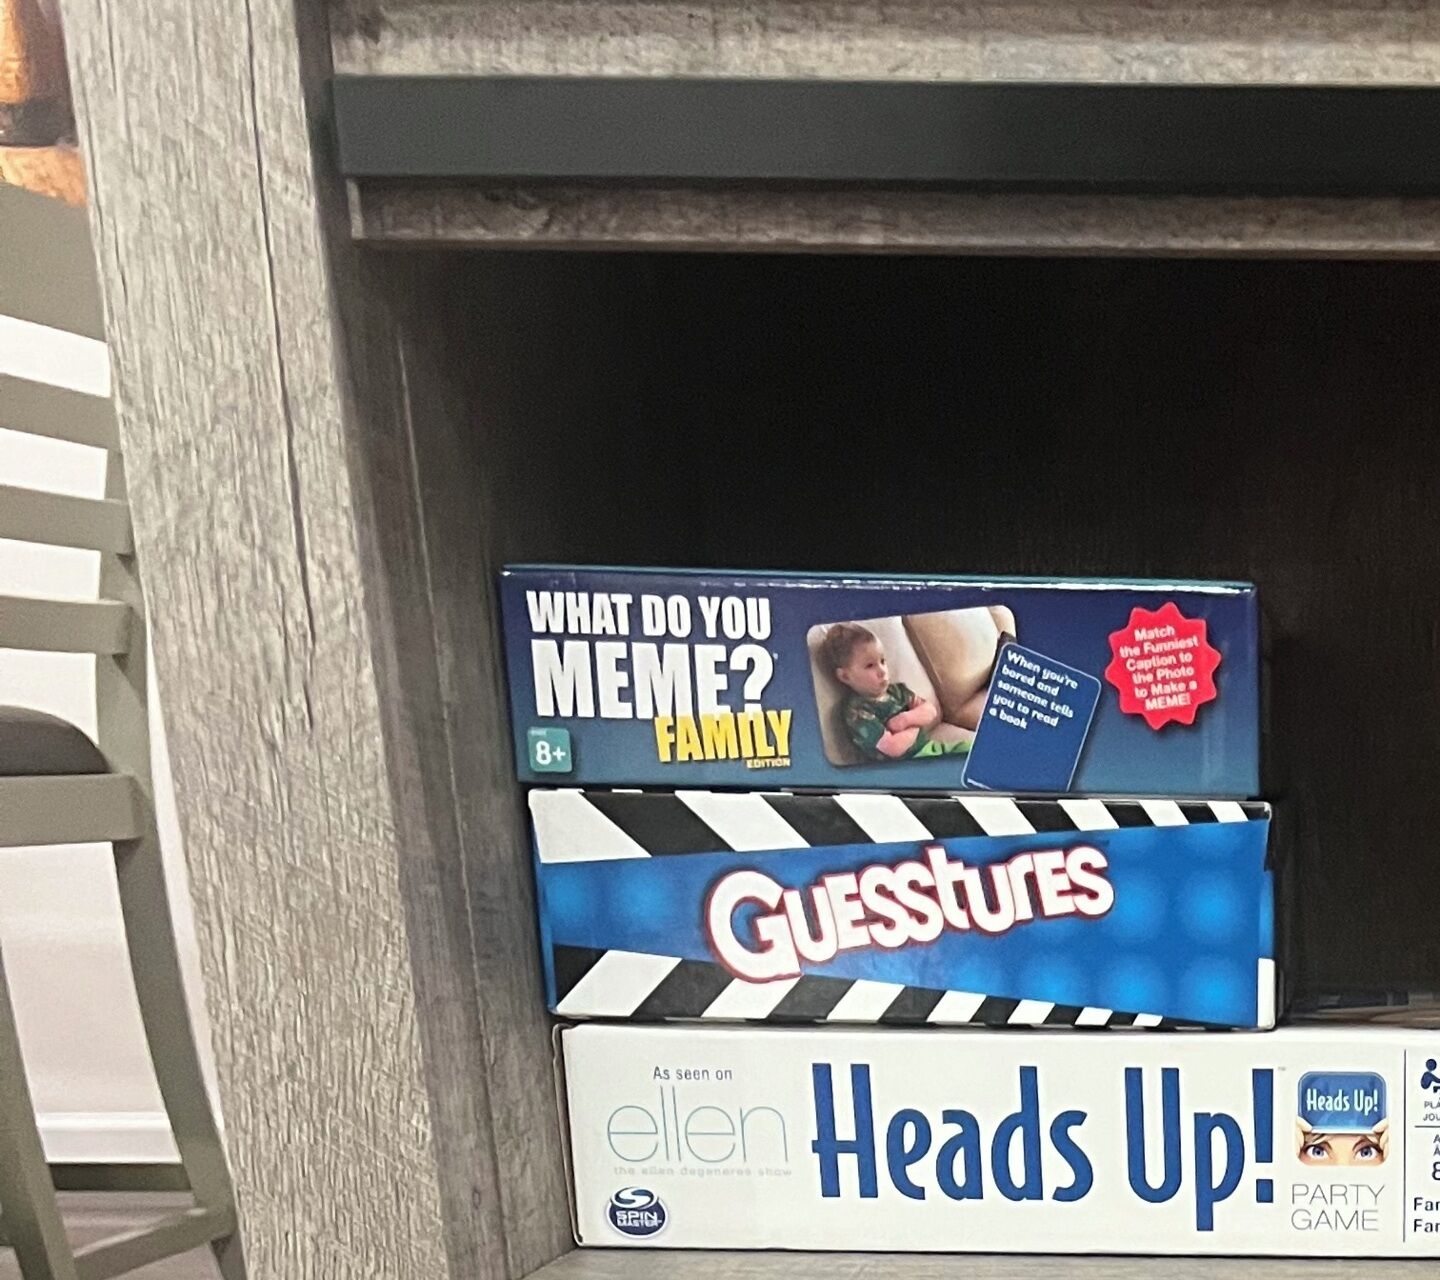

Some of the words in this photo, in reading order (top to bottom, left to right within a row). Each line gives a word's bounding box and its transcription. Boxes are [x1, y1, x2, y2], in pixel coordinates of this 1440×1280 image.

[526, 590, 633, 636] WHAT
[641, 594, 692, 638] DO
[698, 596, 772, 640] YOU
[1134, 625, 1175, 641] Match
[1119, 645, 1141, 658] the
[1143, 635, 1199, 654] Funniest
[1007, 650, 1041, 673] When
[1043, 667, 1078, 689] you're
[1126, 654, 1177, 671] Caption
[1179, 652, 1193, 664] to
[531, 639, 774, 720] MEME?
[1001, 664, 1036, 687] bored
[1037, 681, 1060, 697] and
[1132, 672, 1154, 685] the
[1156, 666, 1195, 681] Photo
[997, 680, 1049, 708] someone
[1051, 701, 1074, 719] tells
[1134, 687, 1149, 698] to
[1150, 681, 1187, 696] Make
[1189, 680, 1198, 690] a
[993, 693, 1016, 710] you
[1017, 702, 1030, 715] to
[1031, 710, 1060, 728] read
[1145, 692, 1192, 711] MEME!
[989, 707, 997, 717] a
[999, 709, 1028, 730] book
[654, 709, 793, 763] FAMILY
[535, 741, 566, 766] 8+
[746, 758, 791, 768] EDITION
[653, 1065, 671, 1080] As
[675, 1068, 710, 1081] seen
[715, 1068, 733, 1081] on
[1306, 1088, 1350, 1112] Heads
[1353, 1089, 1379, 1116] Up!
[607, 1085, 788, 1164] ellen
[811, 1062, 1094, 1203] Heads
[1124, 1066, 1275, 1232] Up!
[1291, 1183, 1385, 1205] PARTY
[615, 1210, 658, 1221] SPIN
[1290, 1208, 1380, 1231] GAME
